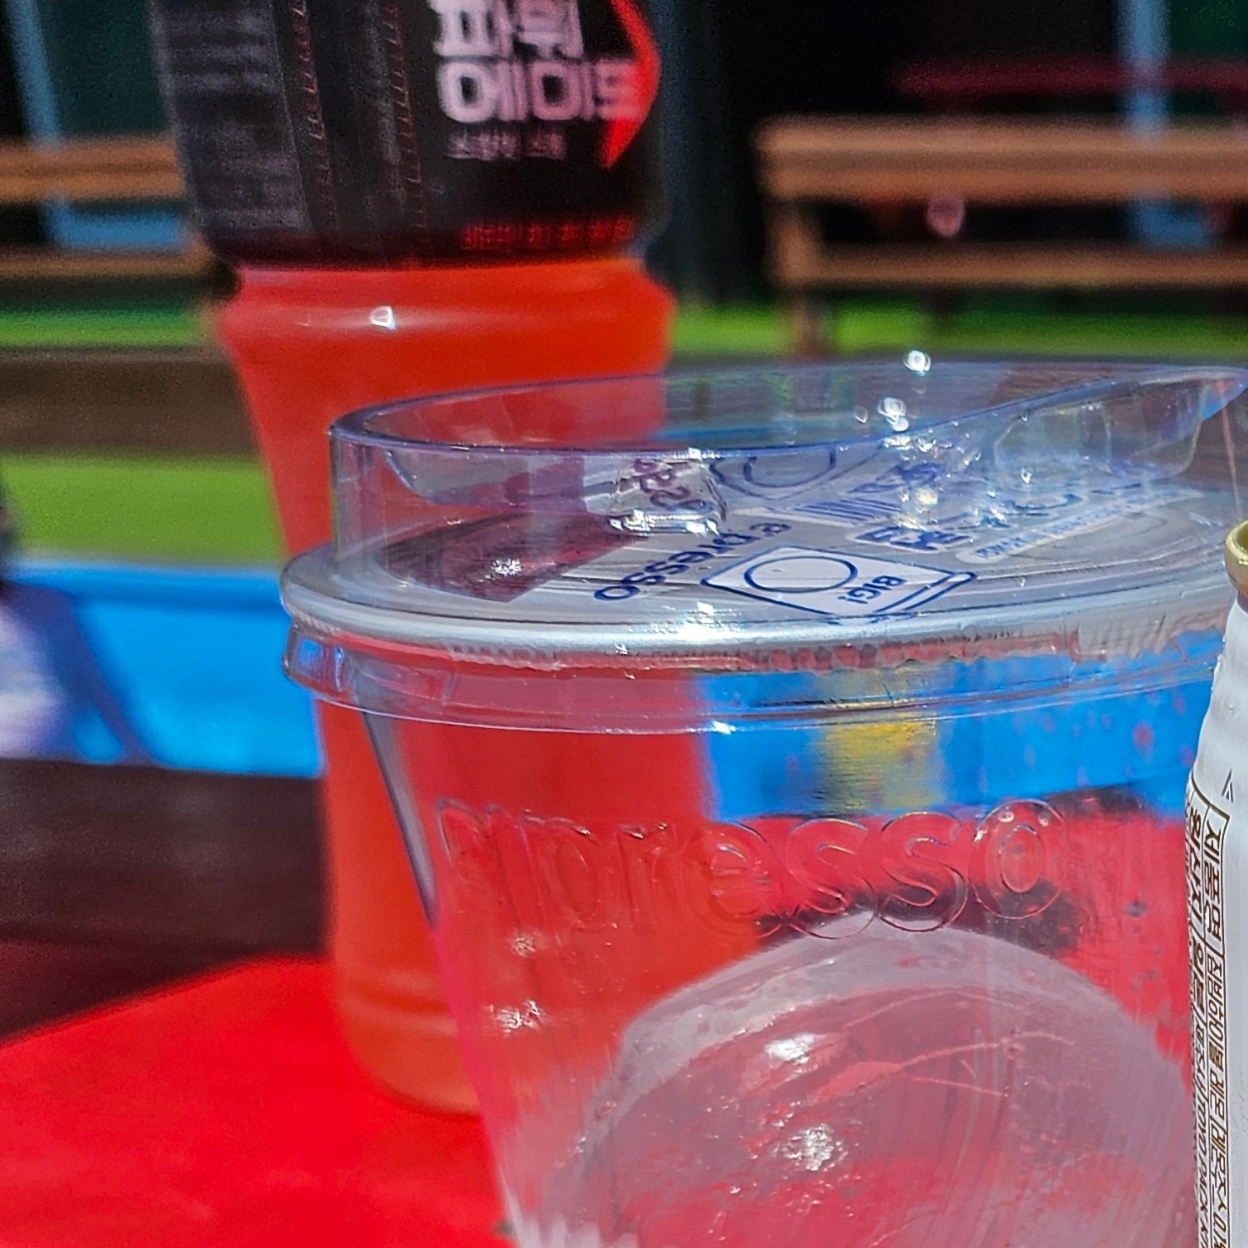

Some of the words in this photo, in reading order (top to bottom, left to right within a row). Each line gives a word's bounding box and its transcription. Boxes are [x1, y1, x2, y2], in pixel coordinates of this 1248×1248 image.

[837, 575, 907, 605] BIG!
[1204, 819, 1222, 941] 제품명
[1210, 1068, 1225, 1121] 레몬
[1210, 1122, 1228, 1212] 레몬주스
